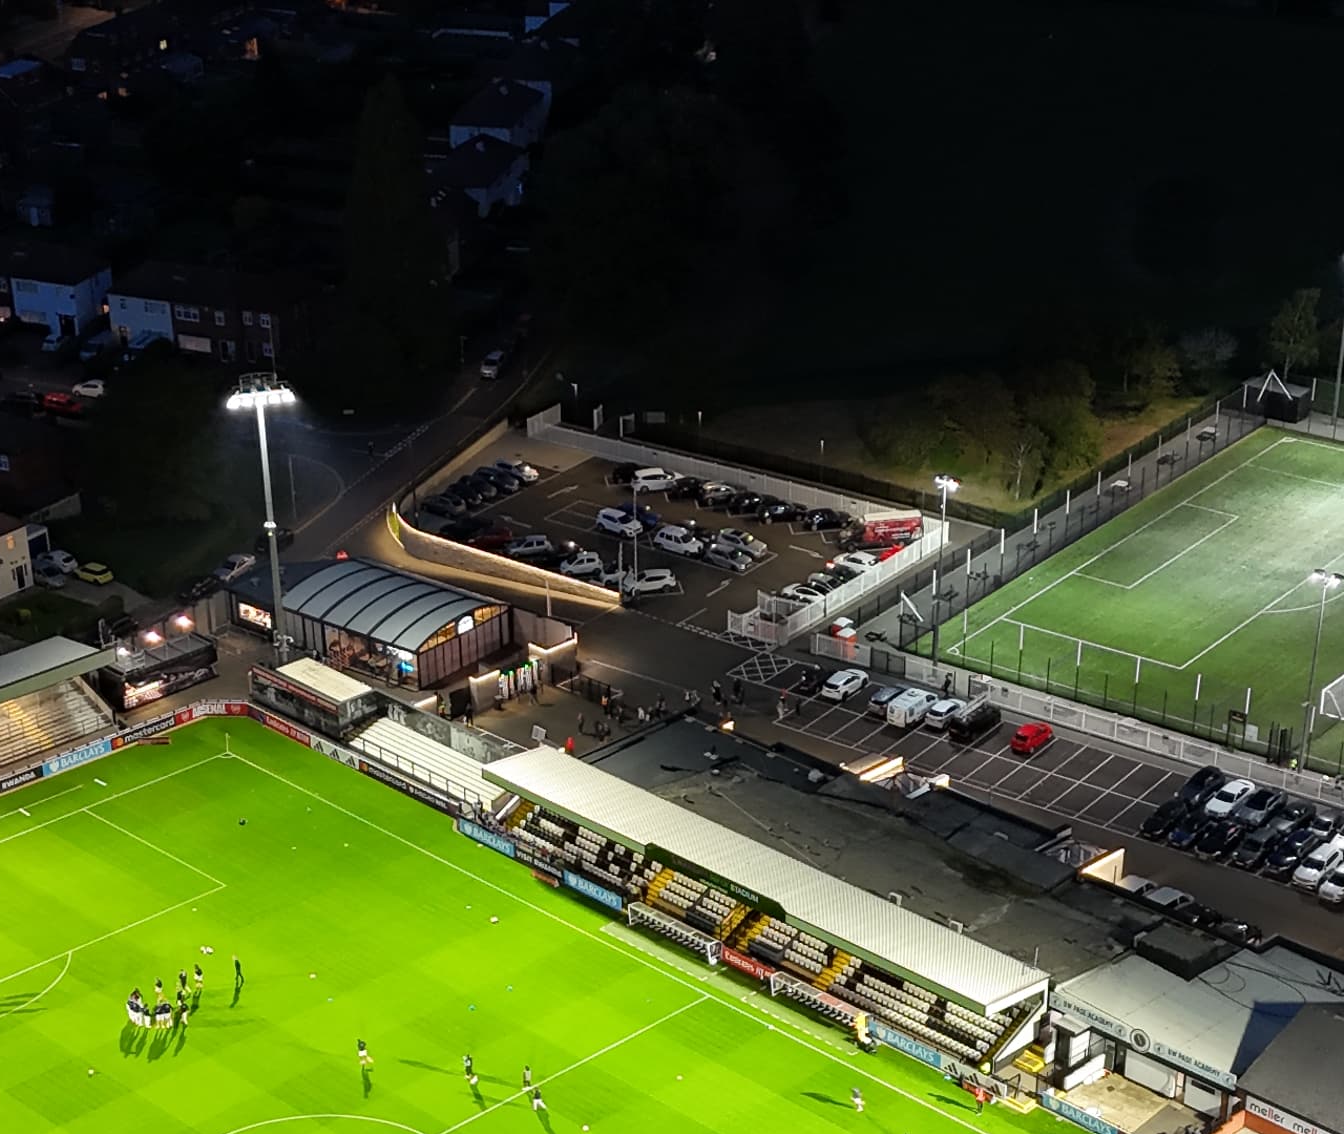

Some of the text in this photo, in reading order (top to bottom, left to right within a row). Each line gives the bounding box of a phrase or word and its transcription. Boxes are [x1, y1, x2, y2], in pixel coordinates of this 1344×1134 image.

[192, 703, 226, 717] ARSENAL
[124, 717, 175, 743] mastercard
[60, 744, 105, 769] BARCLAYS
[2, 771, 37, 793] RWANDA
[472, 828, 510, 855] BARCLAYS
[578, 880, 618, 907] BARCLAYS
[730, 883, 759, 903] STADIUM
[887, 1029, 935, 1062] BARCLAYS
[1249, 1101, 1284, 1124] meller
